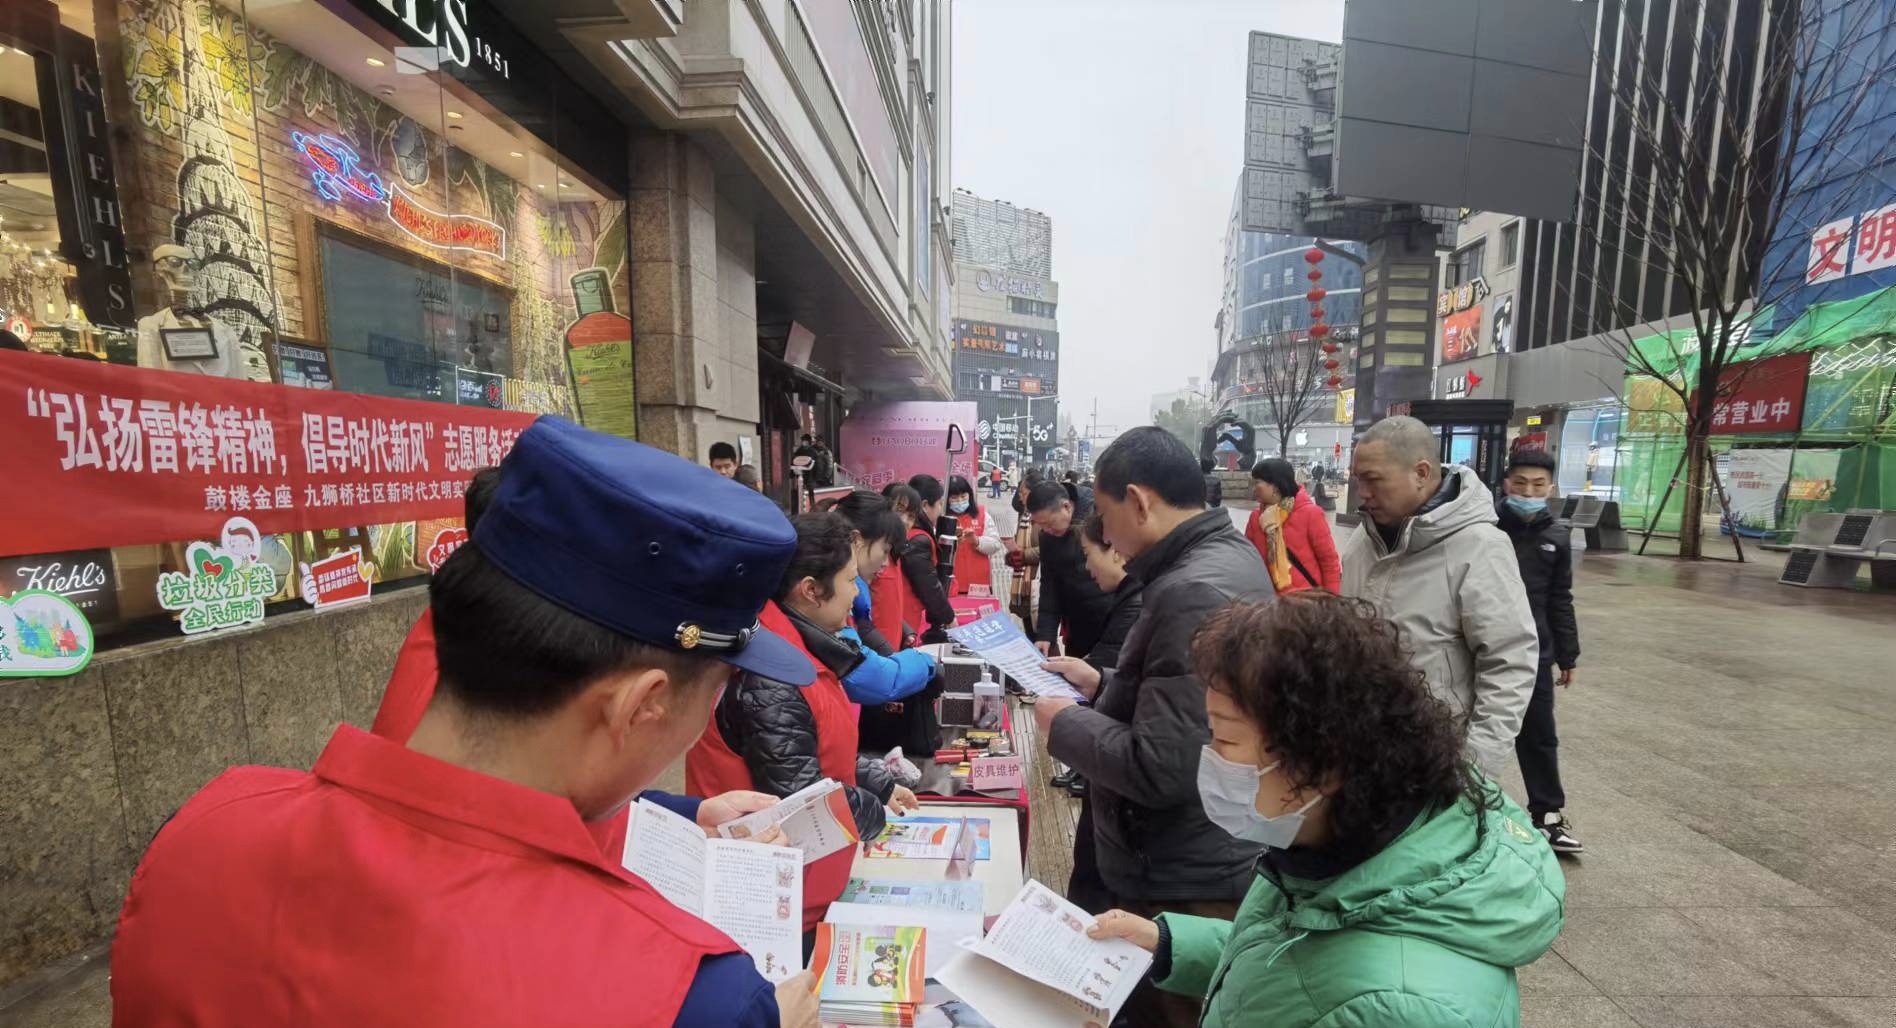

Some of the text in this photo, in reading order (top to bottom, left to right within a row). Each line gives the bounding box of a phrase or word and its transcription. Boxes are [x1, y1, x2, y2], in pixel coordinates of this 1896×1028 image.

[475, 36, 510, 79] 1851
[73, 64, 125, 310] KIEHLS
[1808, 208, 1896, 279] 文明
[1711, 397, 1791, 426] 常营业中
[442, 423, 525, 472] 志愿服务活
[204, 479, 471, 512] 鼓楼金座 九狮桥社区新时代文明实
[16, 562, 106, 593] Kiehl's
[161, 566, 274, 606] 垃圾分类
[184, 597, 262, 631] 全民行动
[974, 764, 1019, 778] 皮具维护
